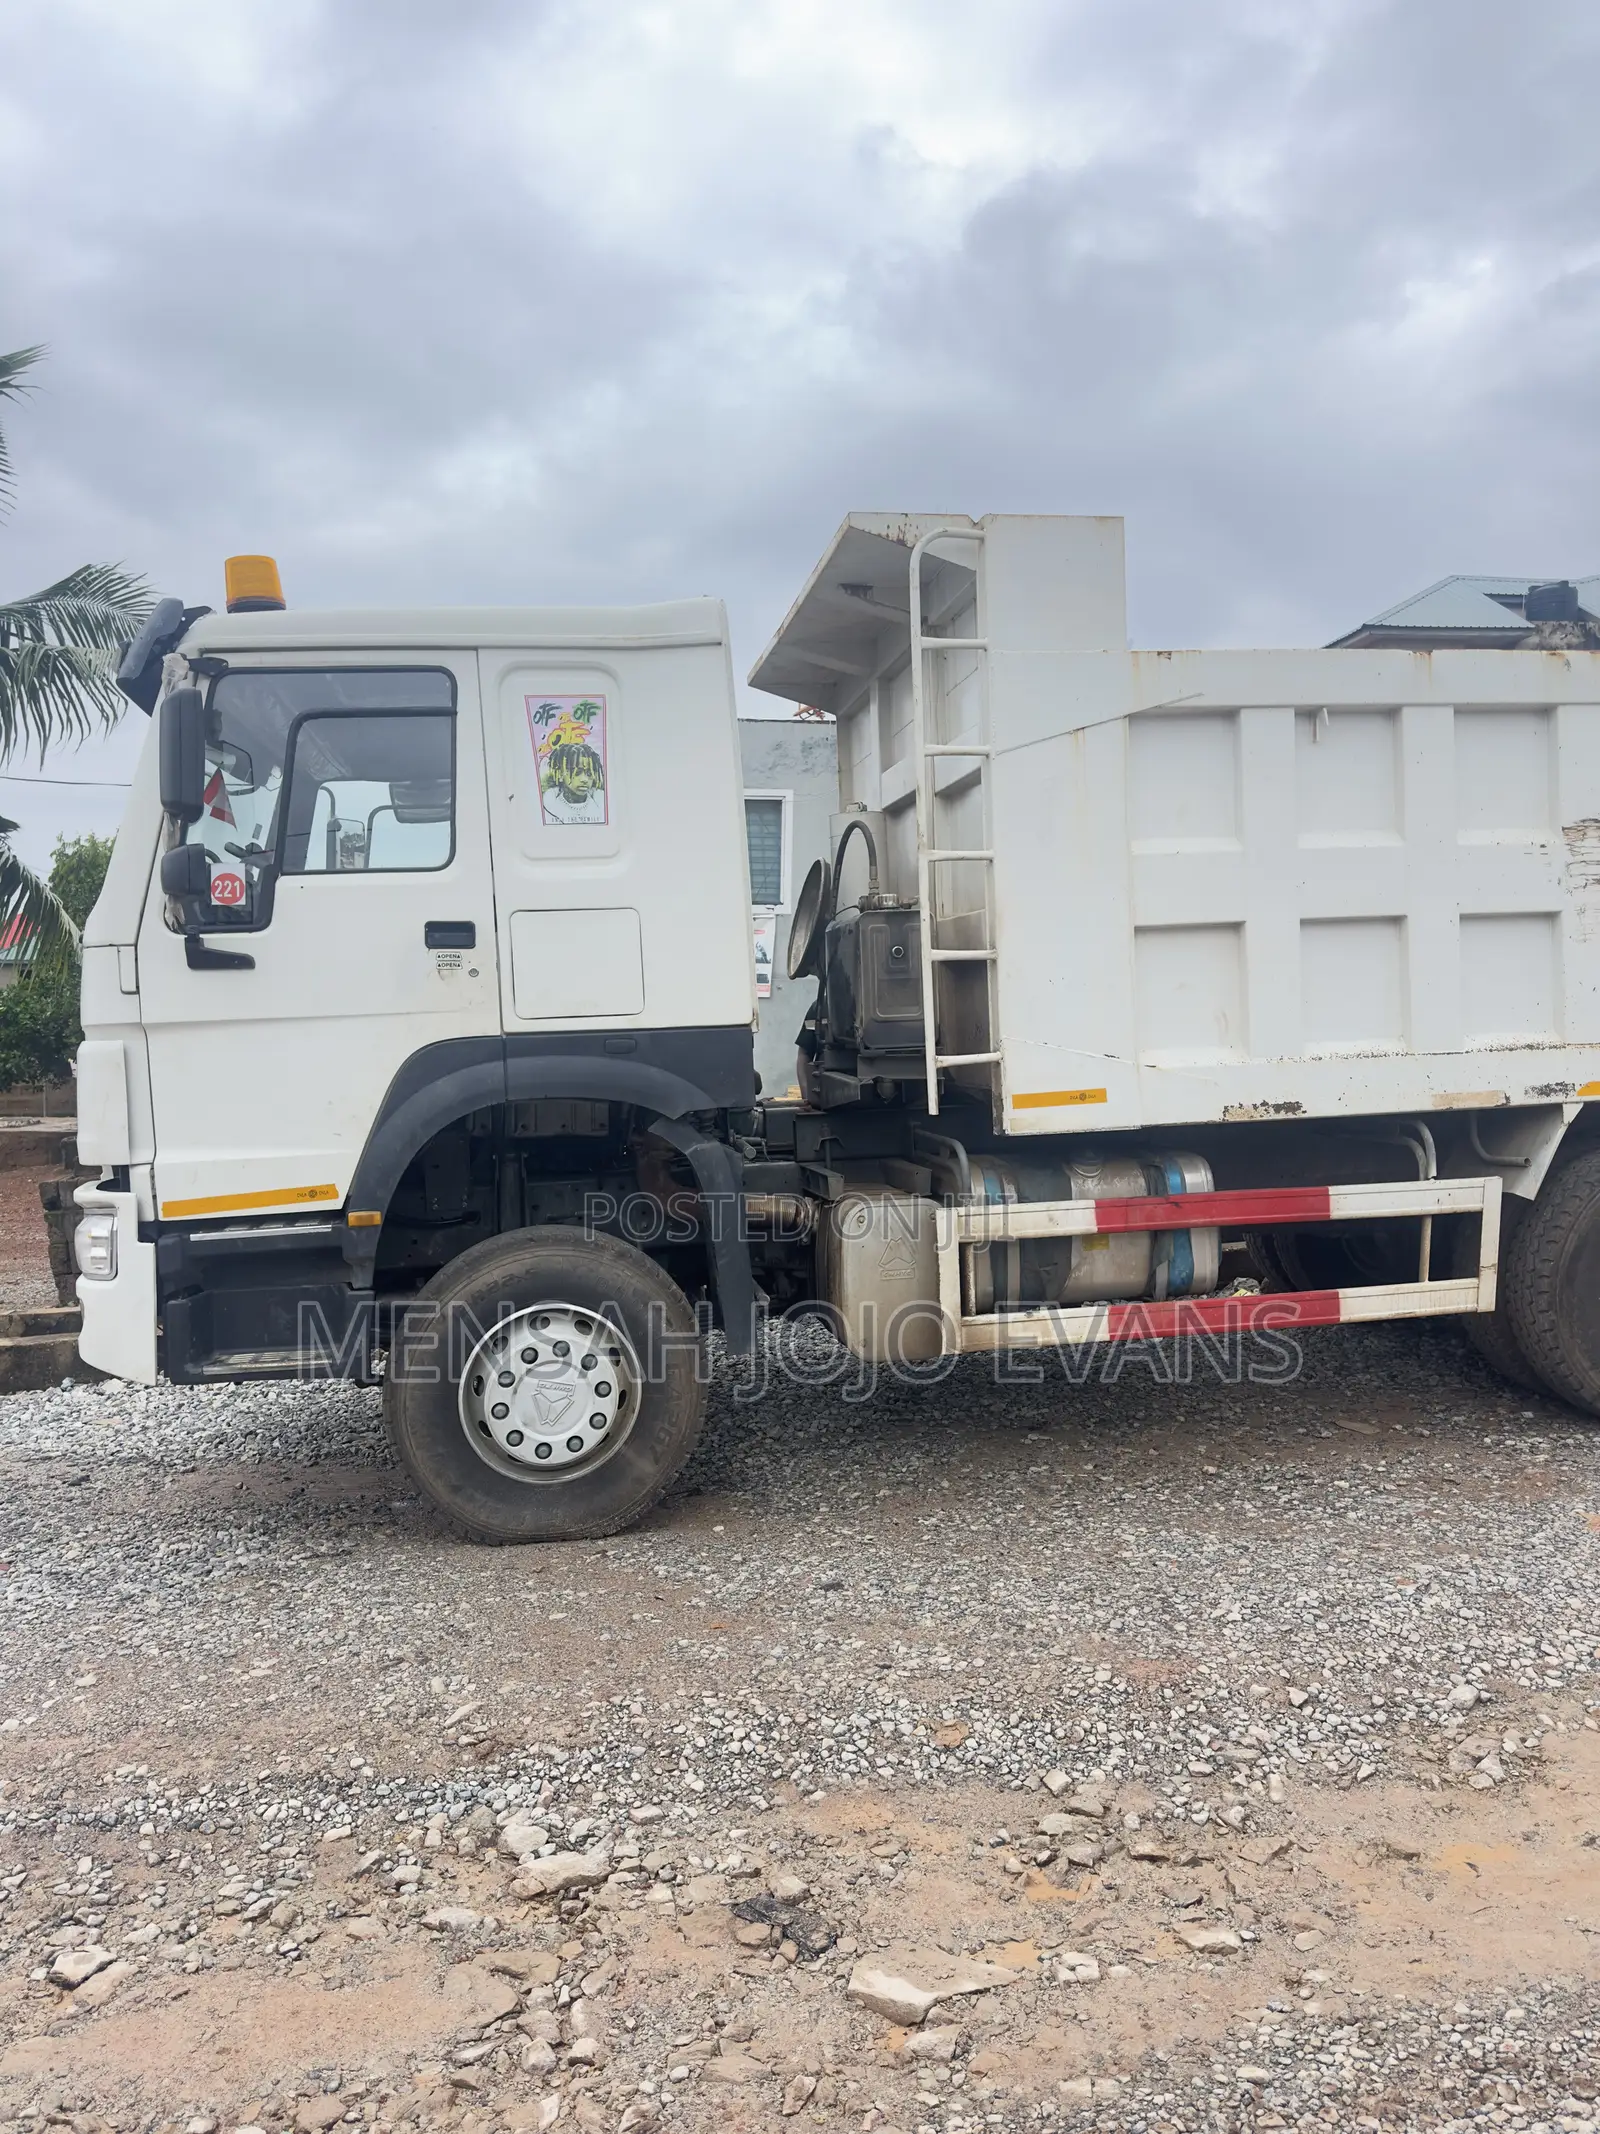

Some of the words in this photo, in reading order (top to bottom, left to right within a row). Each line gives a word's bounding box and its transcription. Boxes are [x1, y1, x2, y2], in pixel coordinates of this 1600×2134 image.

[533, 702, 563, 727] OTF
[572, 701, 602, 724] OTF
[214, 880, 241, 898] 221
